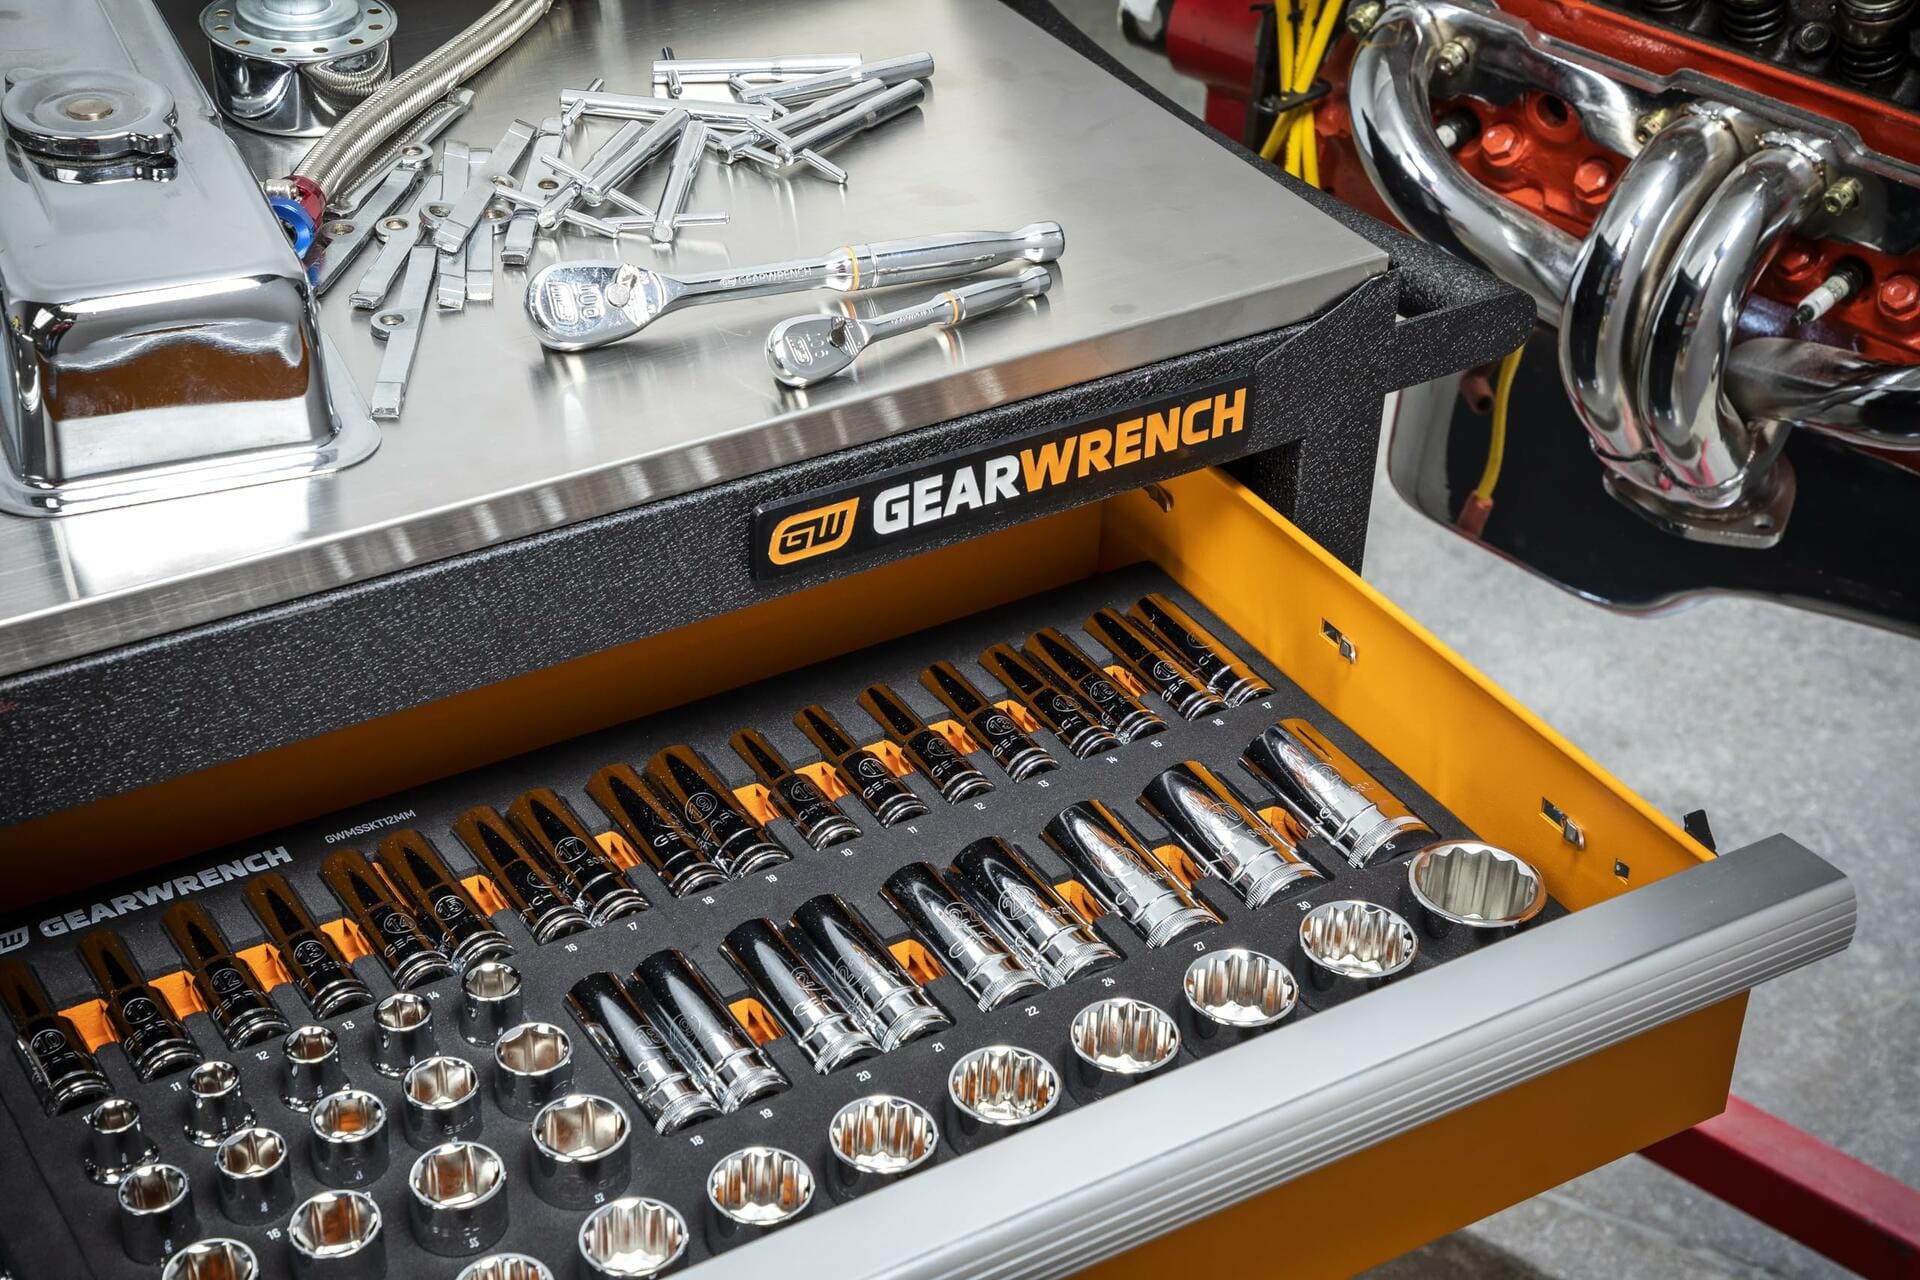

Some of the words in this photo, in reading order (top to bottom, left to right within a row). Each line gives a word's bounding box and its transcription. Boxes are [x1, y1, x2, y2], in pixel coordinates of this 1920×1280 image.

[739, 266, 813, 286] GEARWRENCH
[872, 387, 1247, 536] GEARWRENCH
[1261, 701, 1272, 710] 17
[1212, 718, 1225, 727] 16
[1150, 740, 1163, 749] 15
[1106, 756, 1118, 764] 14
[1038, 779, 1050, 788] 13
[687, 794, 713, 821] 19
[974, 802, 987, 812] 12
[324, 809, 417, 844] GWMSSKT12MM
[907, 825, 918, 835] 11
[557, 838, 582, 861] 17
[841, 847, 855, 858] 10
[765, 873, 778, 884] 19
[39, 846, 294, 938] GEARWRENCH
[702, 895, 715, 906] 18
[1296, 900, 1312, 911] 30
[436, 897, 463, 919] 15
[627, 922, 638, 931] 17
[565, 943, 578, 953] 16
[1193, 941, 1206, 952] 27
[212, 971, 241, 991] 12
[1102, 977, 1116, 987] 24
[427, 991, 440, 1001] 14
[1025, 1005, 1040, 1017] 22
[342, 1020, 355, 1031] 13
[932, 1042, 945, 1053] 21
[255, 1050, 270, 1061] 12
[856, 1069, 872, 1083] 20
[170, 1081, 183, 1092] 11
[82, 1113, 92, 1124] 1
[759, 1108, 774, 1120] 19
[690, 1135, 705, 1147] 18
[266, 1228, 282, 1240] 16
